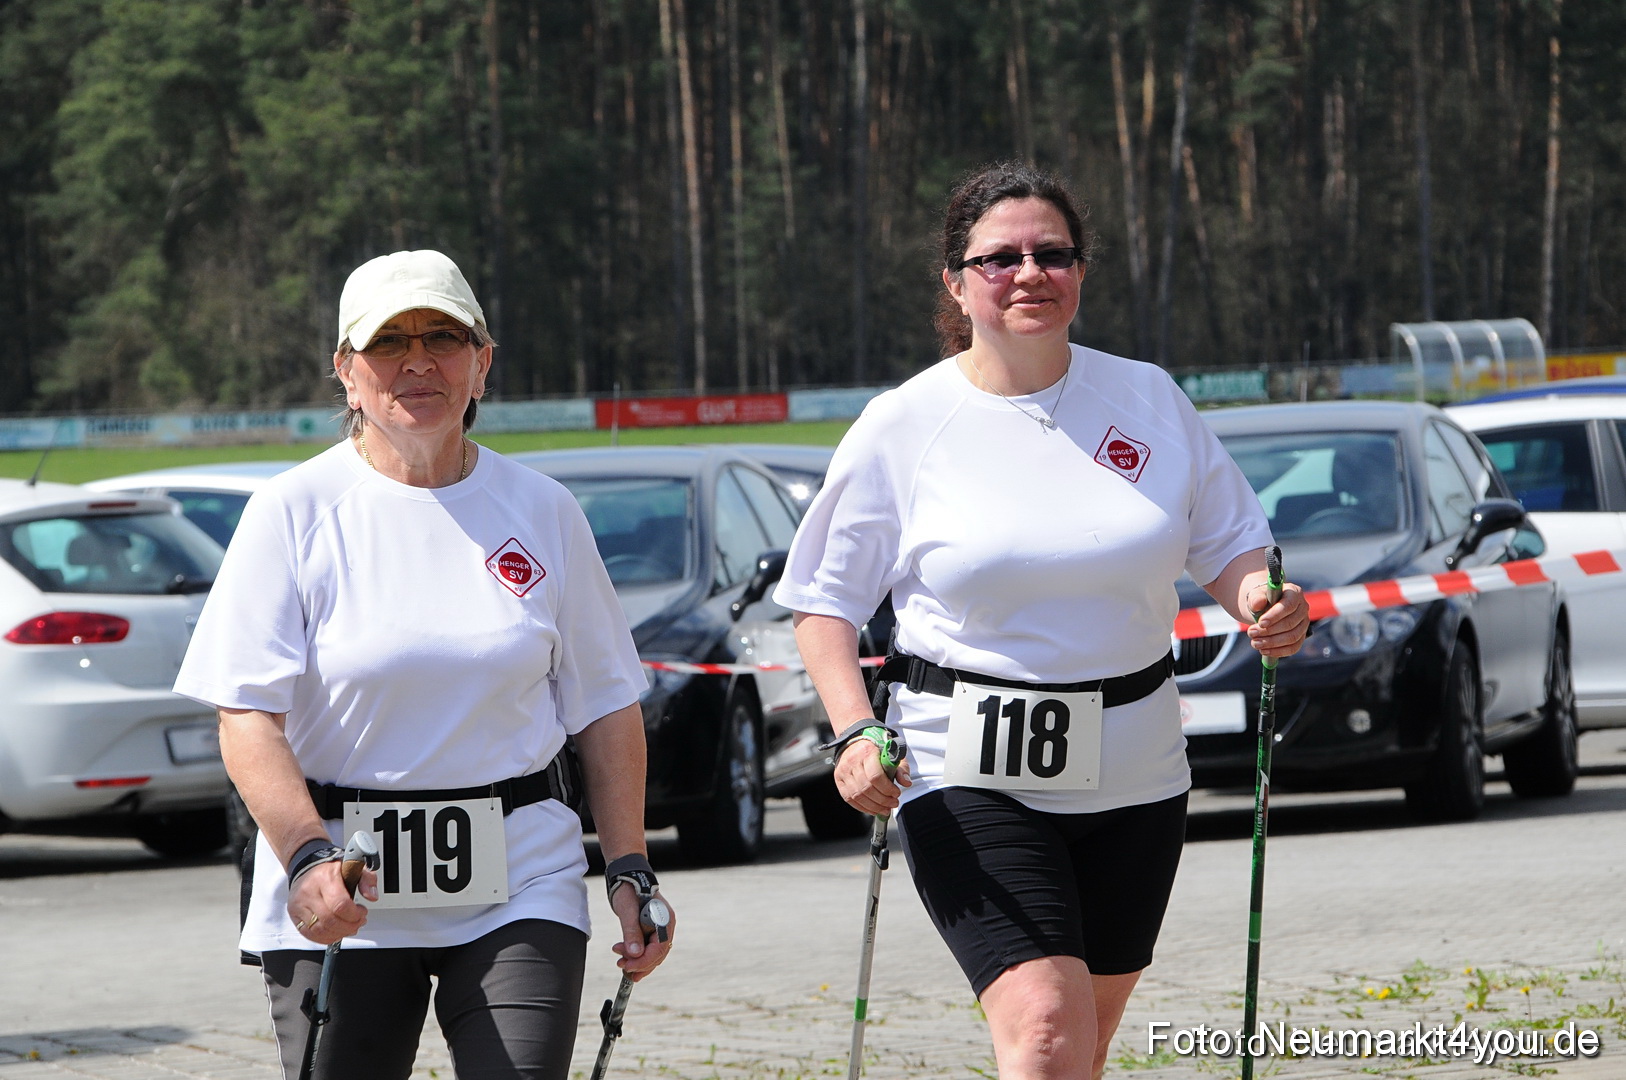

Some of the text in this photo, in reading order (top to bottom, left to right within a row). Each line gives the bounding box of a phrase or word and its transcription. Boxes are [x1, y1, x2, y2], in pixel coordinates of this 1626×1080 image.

[1118, 457, 1132, 467] SV
[499, 561, 530, 570] HENGER
[508, 569, 524, 581] SV
[976, 694, 1071, 779] 118
[373, 805, 472, 894] 119
